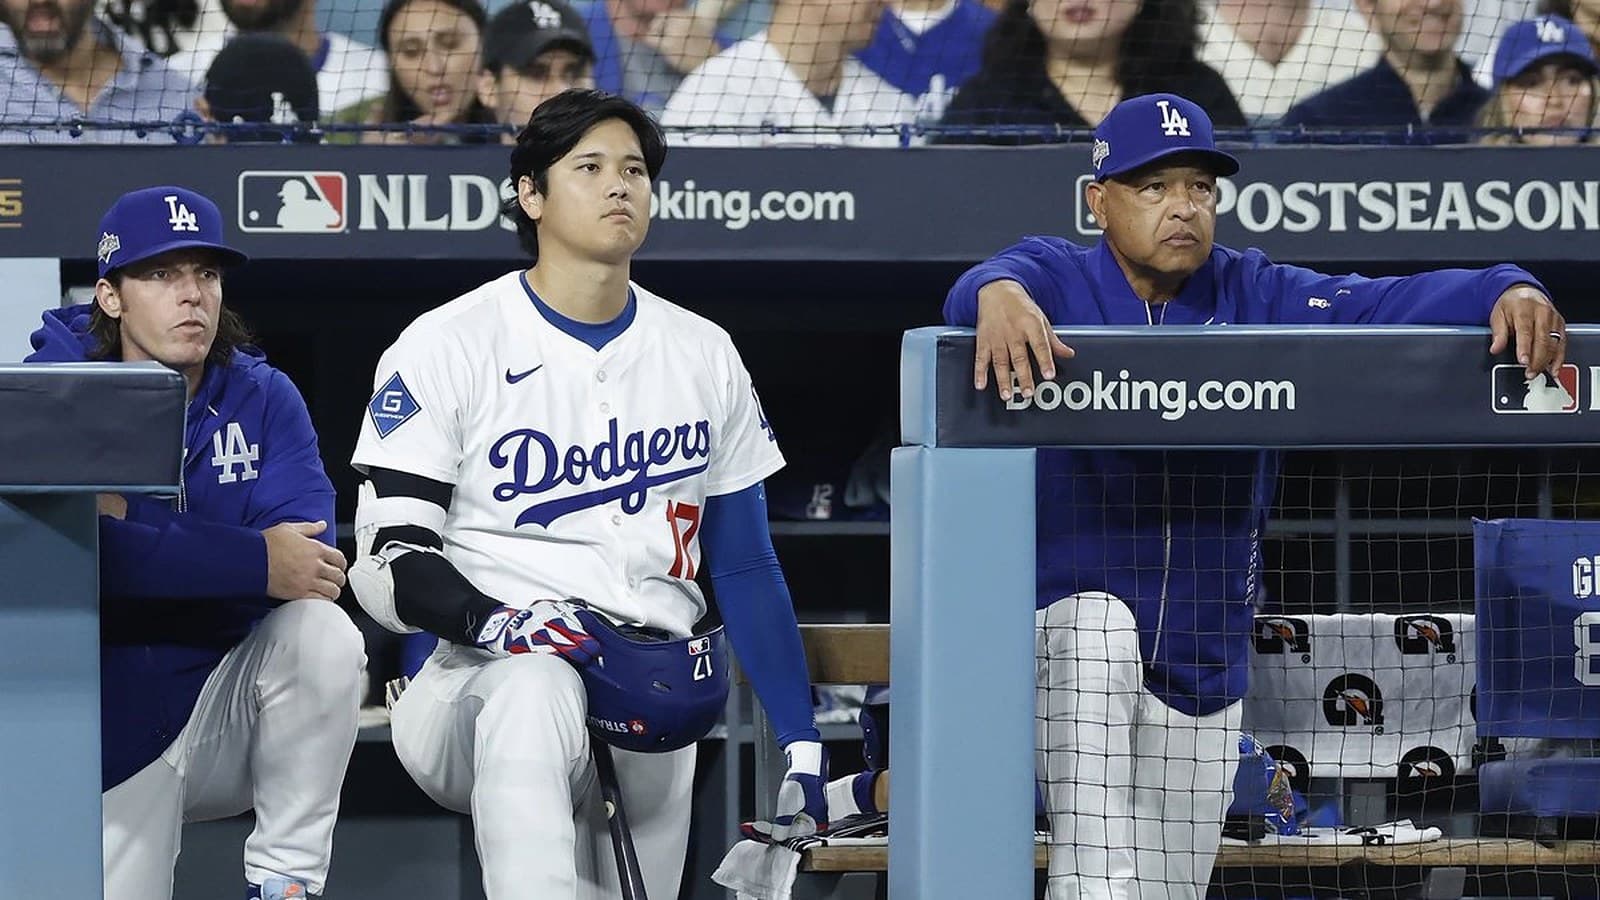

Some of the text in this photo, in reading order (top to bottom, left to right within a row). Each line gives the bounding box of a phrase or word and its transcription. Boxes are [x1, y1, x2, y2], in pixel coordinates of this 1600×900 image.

[1156, 101, 1191, 136] LA
[164, 196, 199, 231] LA
[650, 179, 855, 230] king.com
[211, 422, 259, 484] LA
[489, 417, 710, 516] Dodgers
[666, 500, 700, 580] 17
[693, 655, 712, 681] 17
